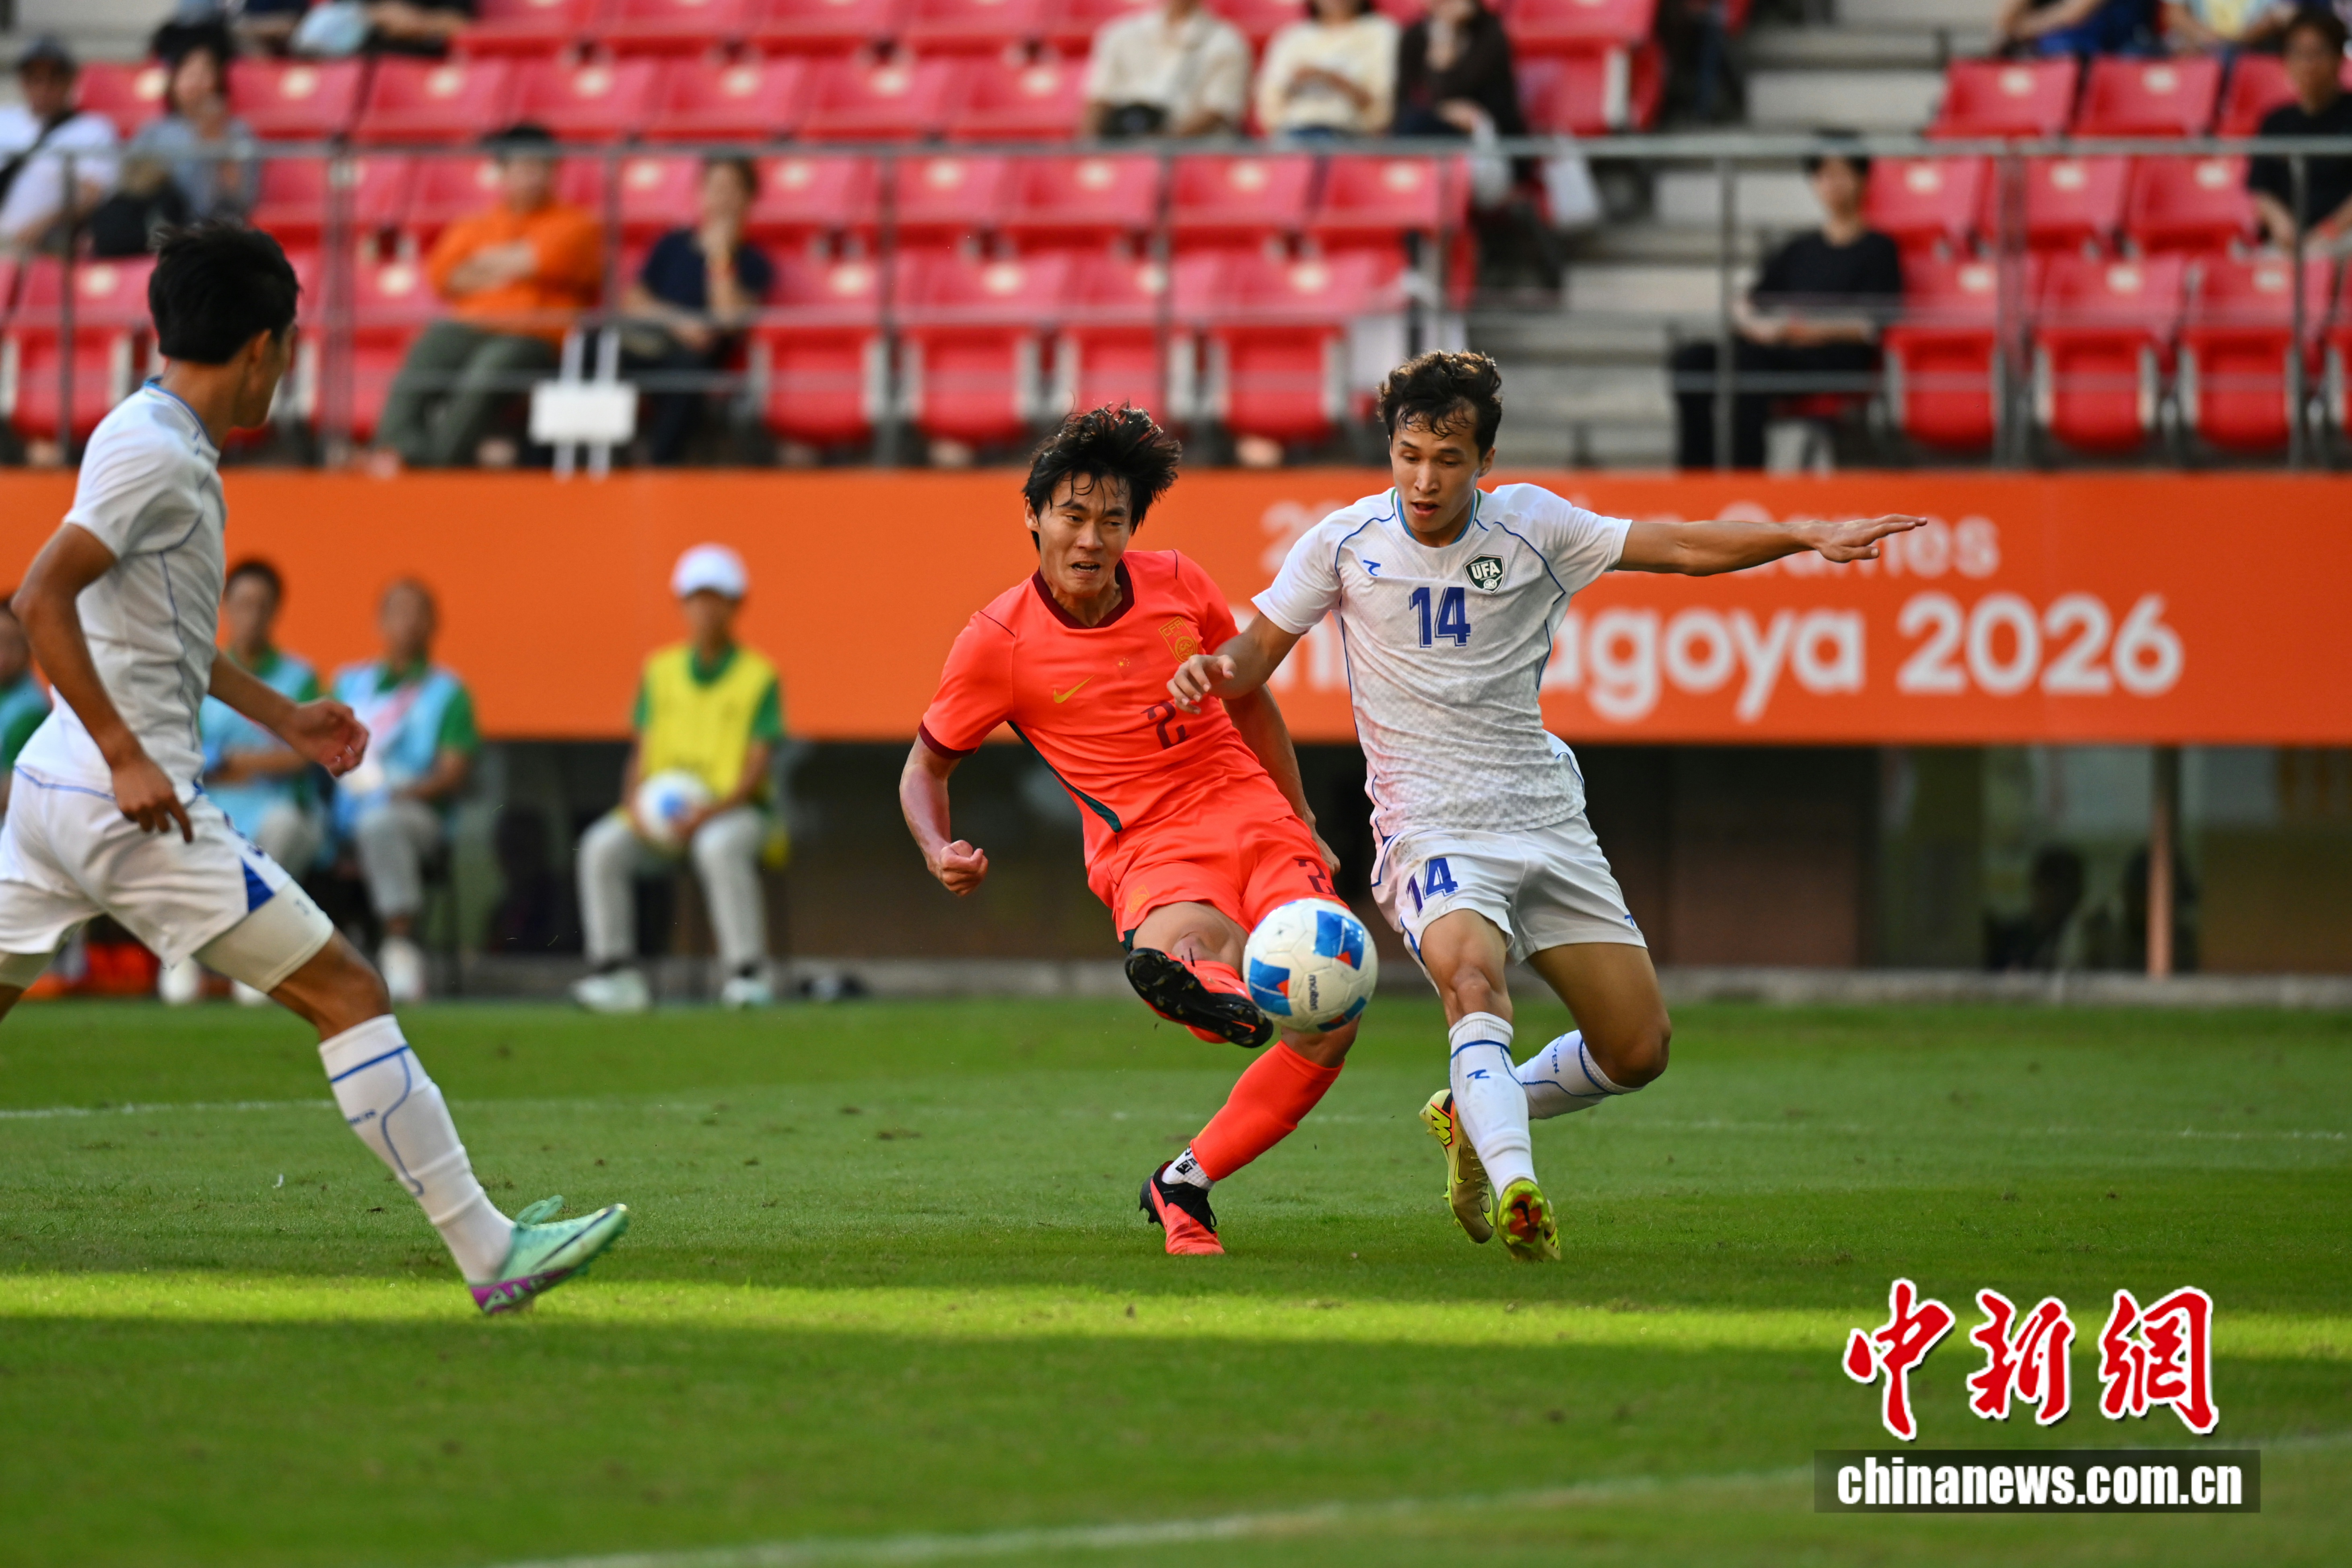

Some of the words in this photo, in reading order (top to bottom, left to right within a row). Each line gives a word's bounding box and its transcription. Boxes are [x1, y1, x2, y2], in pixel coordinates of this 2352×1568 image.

[1471, 562, 1501, 579] UFA
[1162, 620, 1184, 637] CFA
[1409, 586, 1471, 648] 14
[1897, 591, 2185, 697] 2026
[1140, 701, 1190, 751] 2
[1405, 857, 1458, 918] 14
